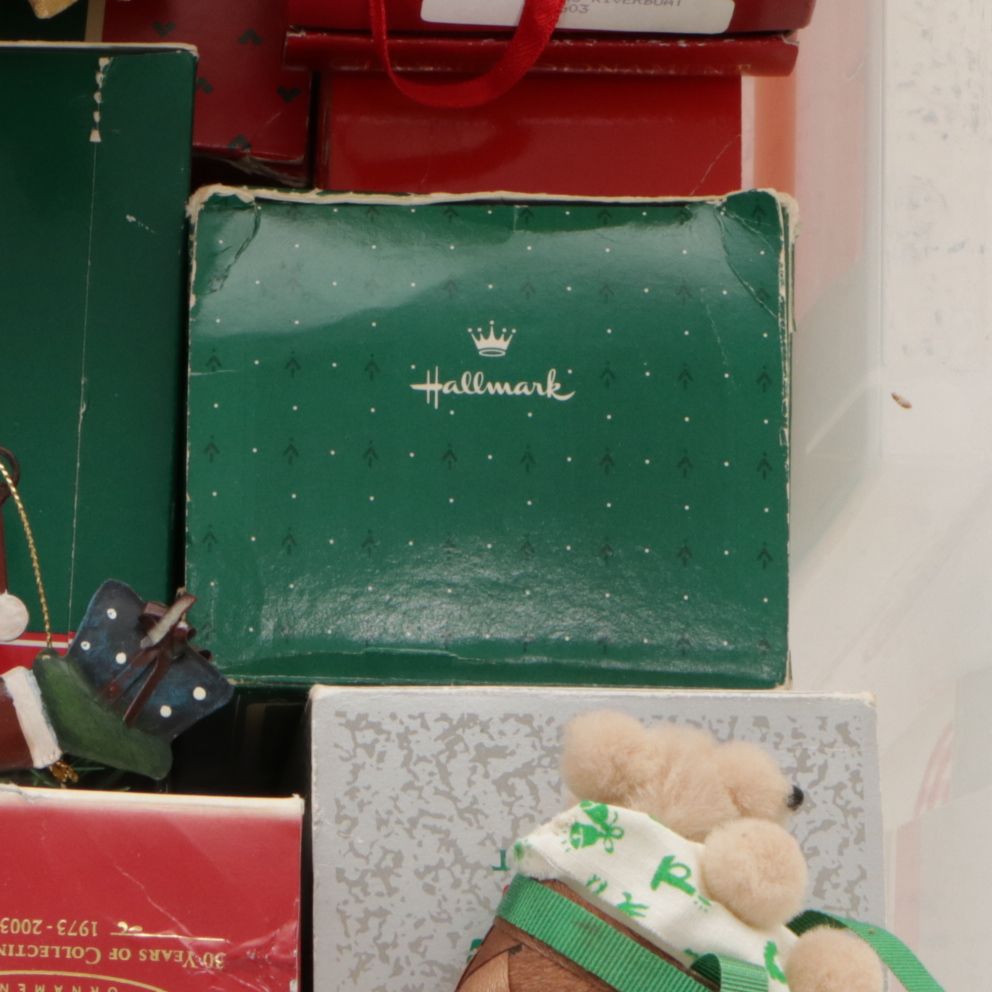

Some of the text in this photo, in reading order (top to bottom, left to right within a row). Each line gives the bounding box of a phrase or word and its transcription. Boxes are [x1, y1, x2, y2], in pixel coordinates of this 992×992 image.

[410, 365, 576, 410] Hallmark
[109, 946, 132, 961] OF
[138, 948, 196, 969] YEARS
[201, 950, 227, 970] 30
